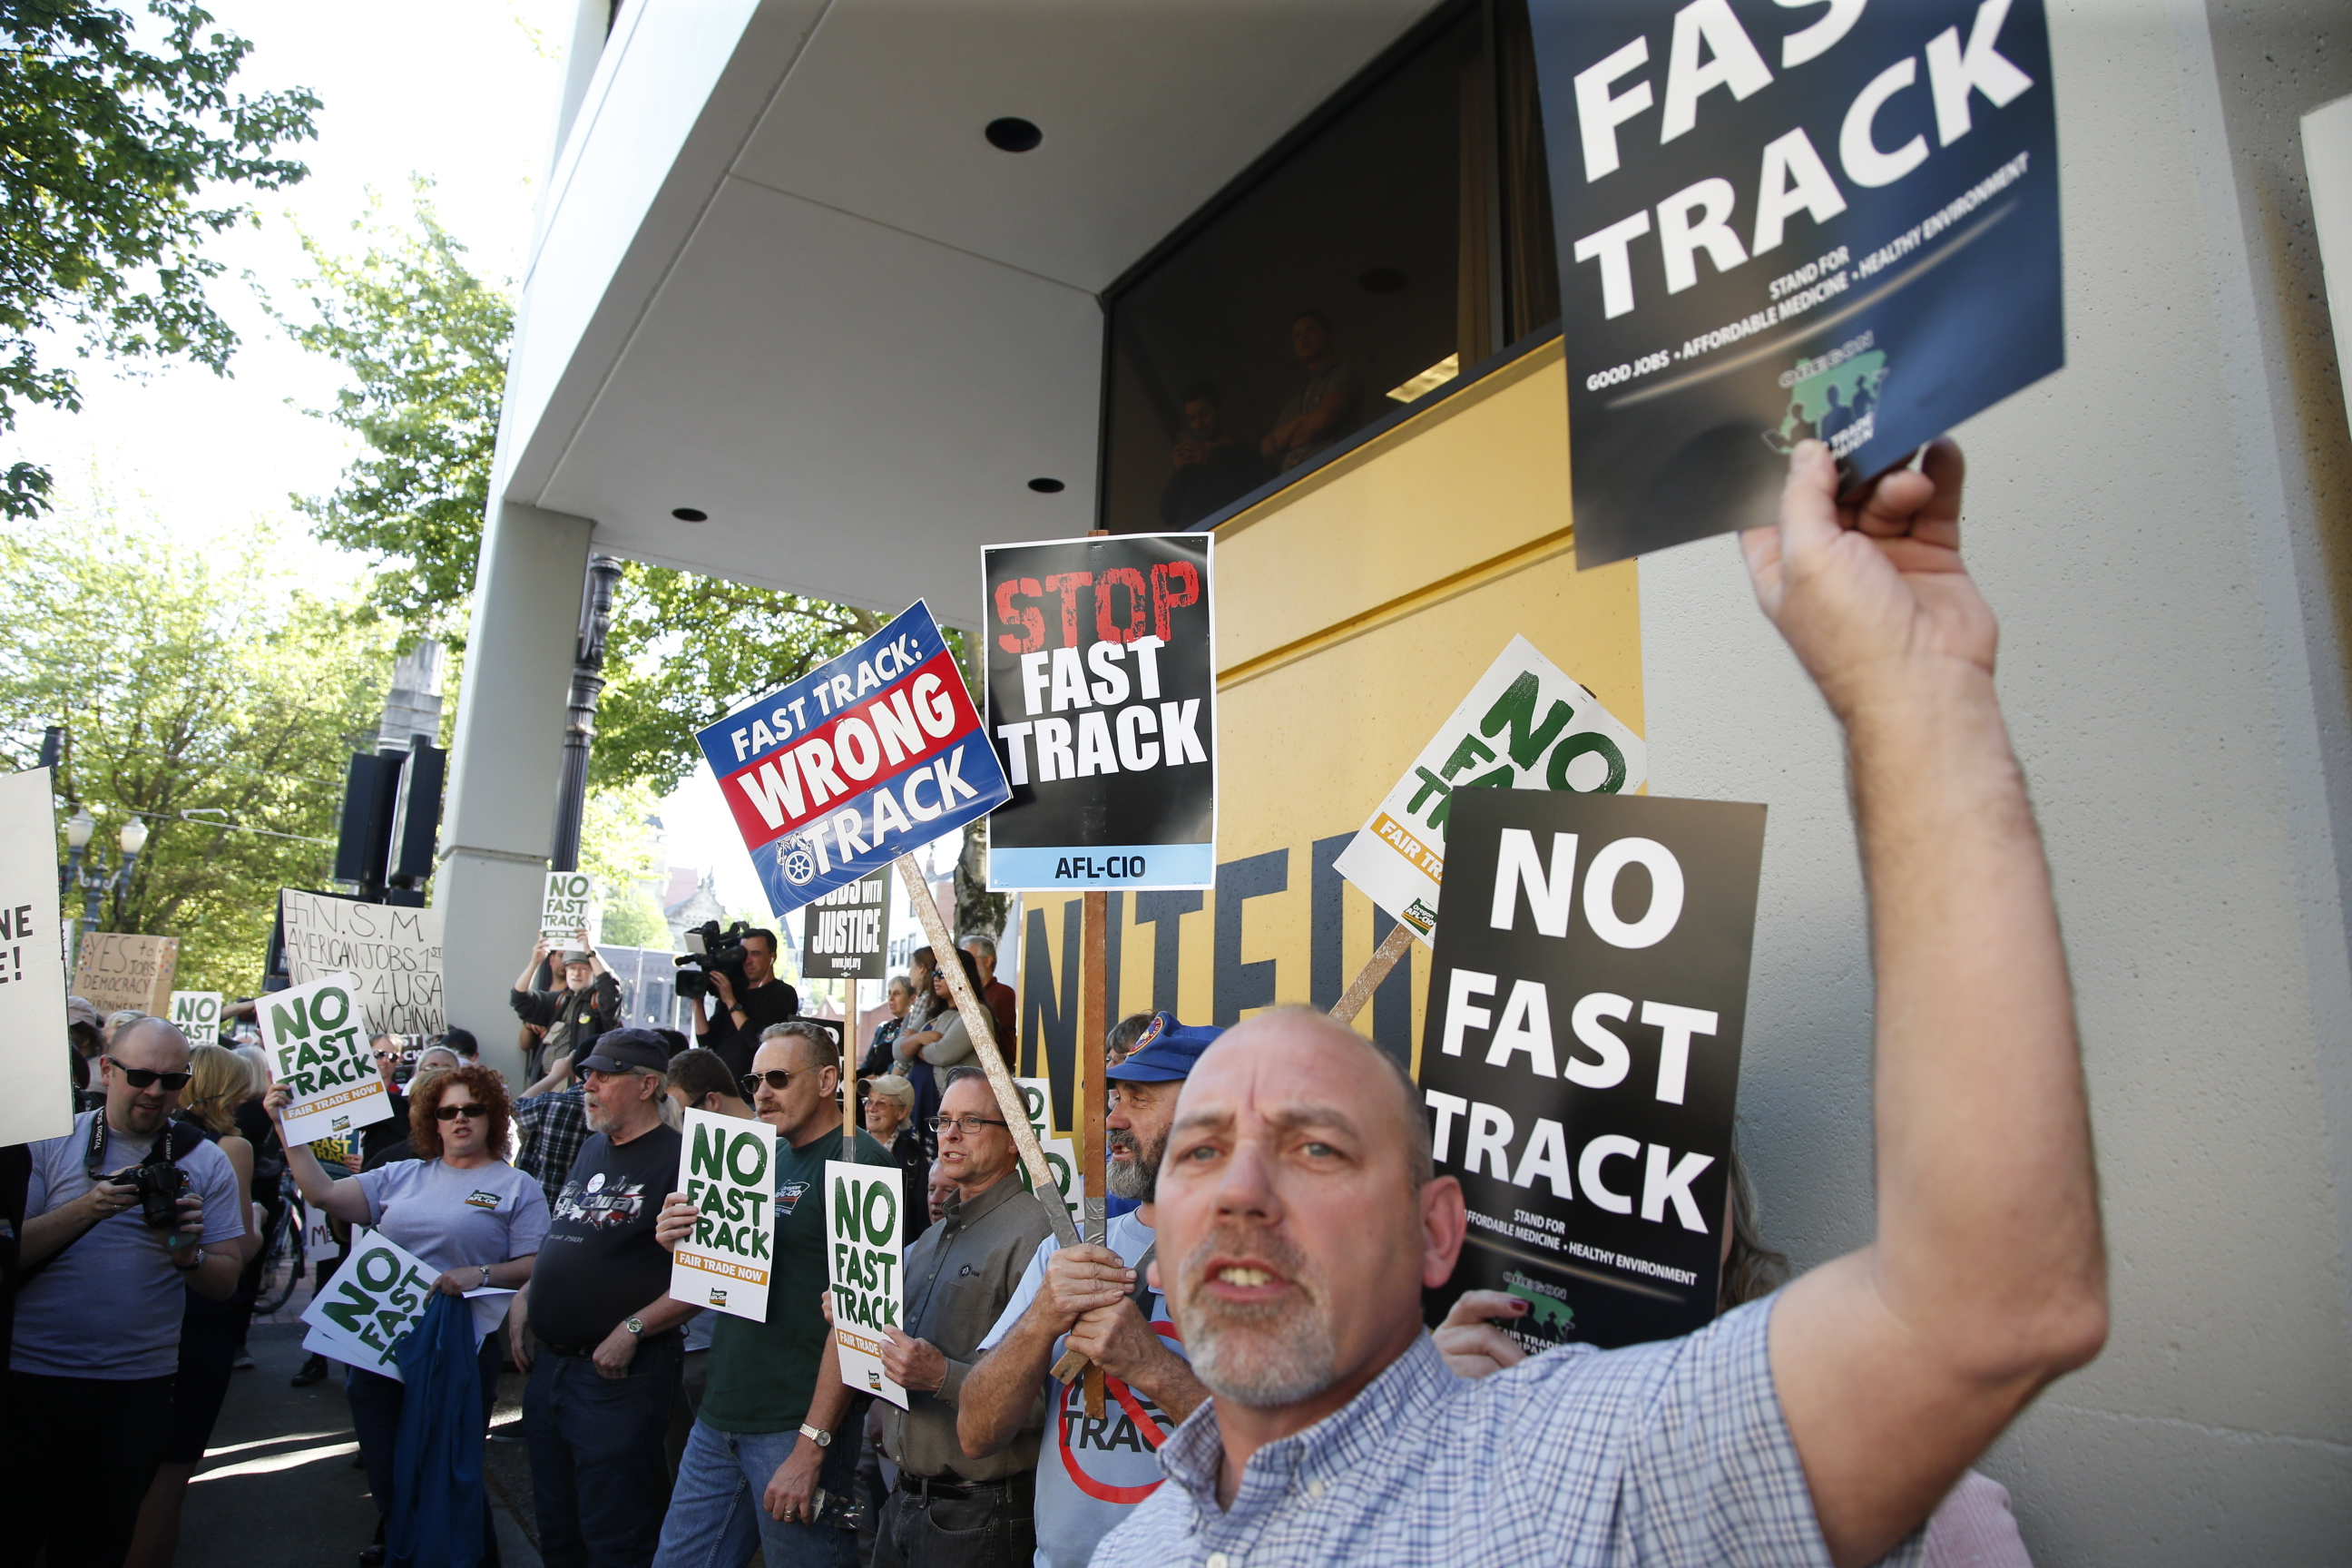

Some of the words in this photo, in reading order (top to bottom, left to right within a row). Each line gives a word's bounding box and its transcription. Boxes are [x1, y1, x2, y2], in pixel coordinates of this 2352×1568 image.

[1574, 0, 2034, 320] TRACK
[1586, 365, 1631, 392] GOOD
[1632, 349, 1670, 378] JOBS
[1681, 305, 1779, 360] AFFORDABLE
[1779, 274, 1849, 321] MEDICINE
[1858, 230, 1922, 279] HEALTHY
[1922, 151, 2030, 242] ENVIRONMENT
[1769, 263, 1818, 300] STAND
[1819, 245, 1850, 279] FOR
[994, 561, 1200, 654] STOP
[731, 696, 807, 763] FAST
[813, 632, 923, 710] TRACK:
[1021, 635, 1165, 716] FAST
[737, 671, 956, 830] WRONG
[997, 699, 1208, 787] TRACK
[1479, 670, 1627, 794] NO
[802, 744, 978, 877] TRACK
[1379, 819, 1422, 860] FAIR
[548, 876, 589, 897] NO
[1054, 856, 1146, 878] AFL-CIO
[1489, 828, 1684, 949] NO
[546, 898, 588, 914] FAST
[862, 879, 883, 904] WITH
[1412, 904, 1435, 919] Oregon
[544, 915, 585, 927] TRACK
[812, 908, 881, 954] JUSTICE
[1405, 907, 1435, 926] AFL-CIO
[90, 935, 132, 974] YES
[128, 960, 156, 977] JOBS
[288, 927, 358, 969] AMERICAN
[360, 942, 416, 972] JOBS
[83, 974, 151, 995] DEMOCRACY
[391, 973, 443, 1007] USA
[177, 997, 217, 1022] NO
[271, 986, 349, 1045] NO
[278, 1026, 358, 1076] FAST
[1441, 967, 1718, 1105] FAST
[276, 1054, 377, 1100] TRACK
[288, 1104, 314, 1118] FAIR
[314, 1093, 350, 1111] TRADE
[351, 1083, 377, 1099] NOW
[691, 1122, 768, 1187] NO
[1426, 1089, 1715, 1235] TRACK
[687, 1179, 769, 1227] FAST
[835, 1176, 897, 1247] NO
[1514, 1209, 1544, 1229] STAND
[1545, 1217, 1565, 1235] FOR
[683, 1217, 769, 1260] RACK
[1514, 1225, 1561, 1250] MEDICINE
[1569, 1240, 1615, 1265] HEALTHY
[1615, 1254, 1697, 1286] ENVIRONMENT
[321, 1247, 401, 1333] NO
[680, 1252, 701, 1268] FAIR
[703, 1259, 736, 1276] TRADE
[738, 1265, 763, 1282] NOW
[835, 1243, 897, 1296] FAST
[1503, 1271, 1567, 1299] OREGON
[358, 1265, 431, 1352] FAST
[832, 1283, 899, 1332] TRACK
[839, 1330, 856, 1349] FAIR
[856, 1336, 879, 1355] TRADE
[1063, 1410, 1179, 1454] TRAC
